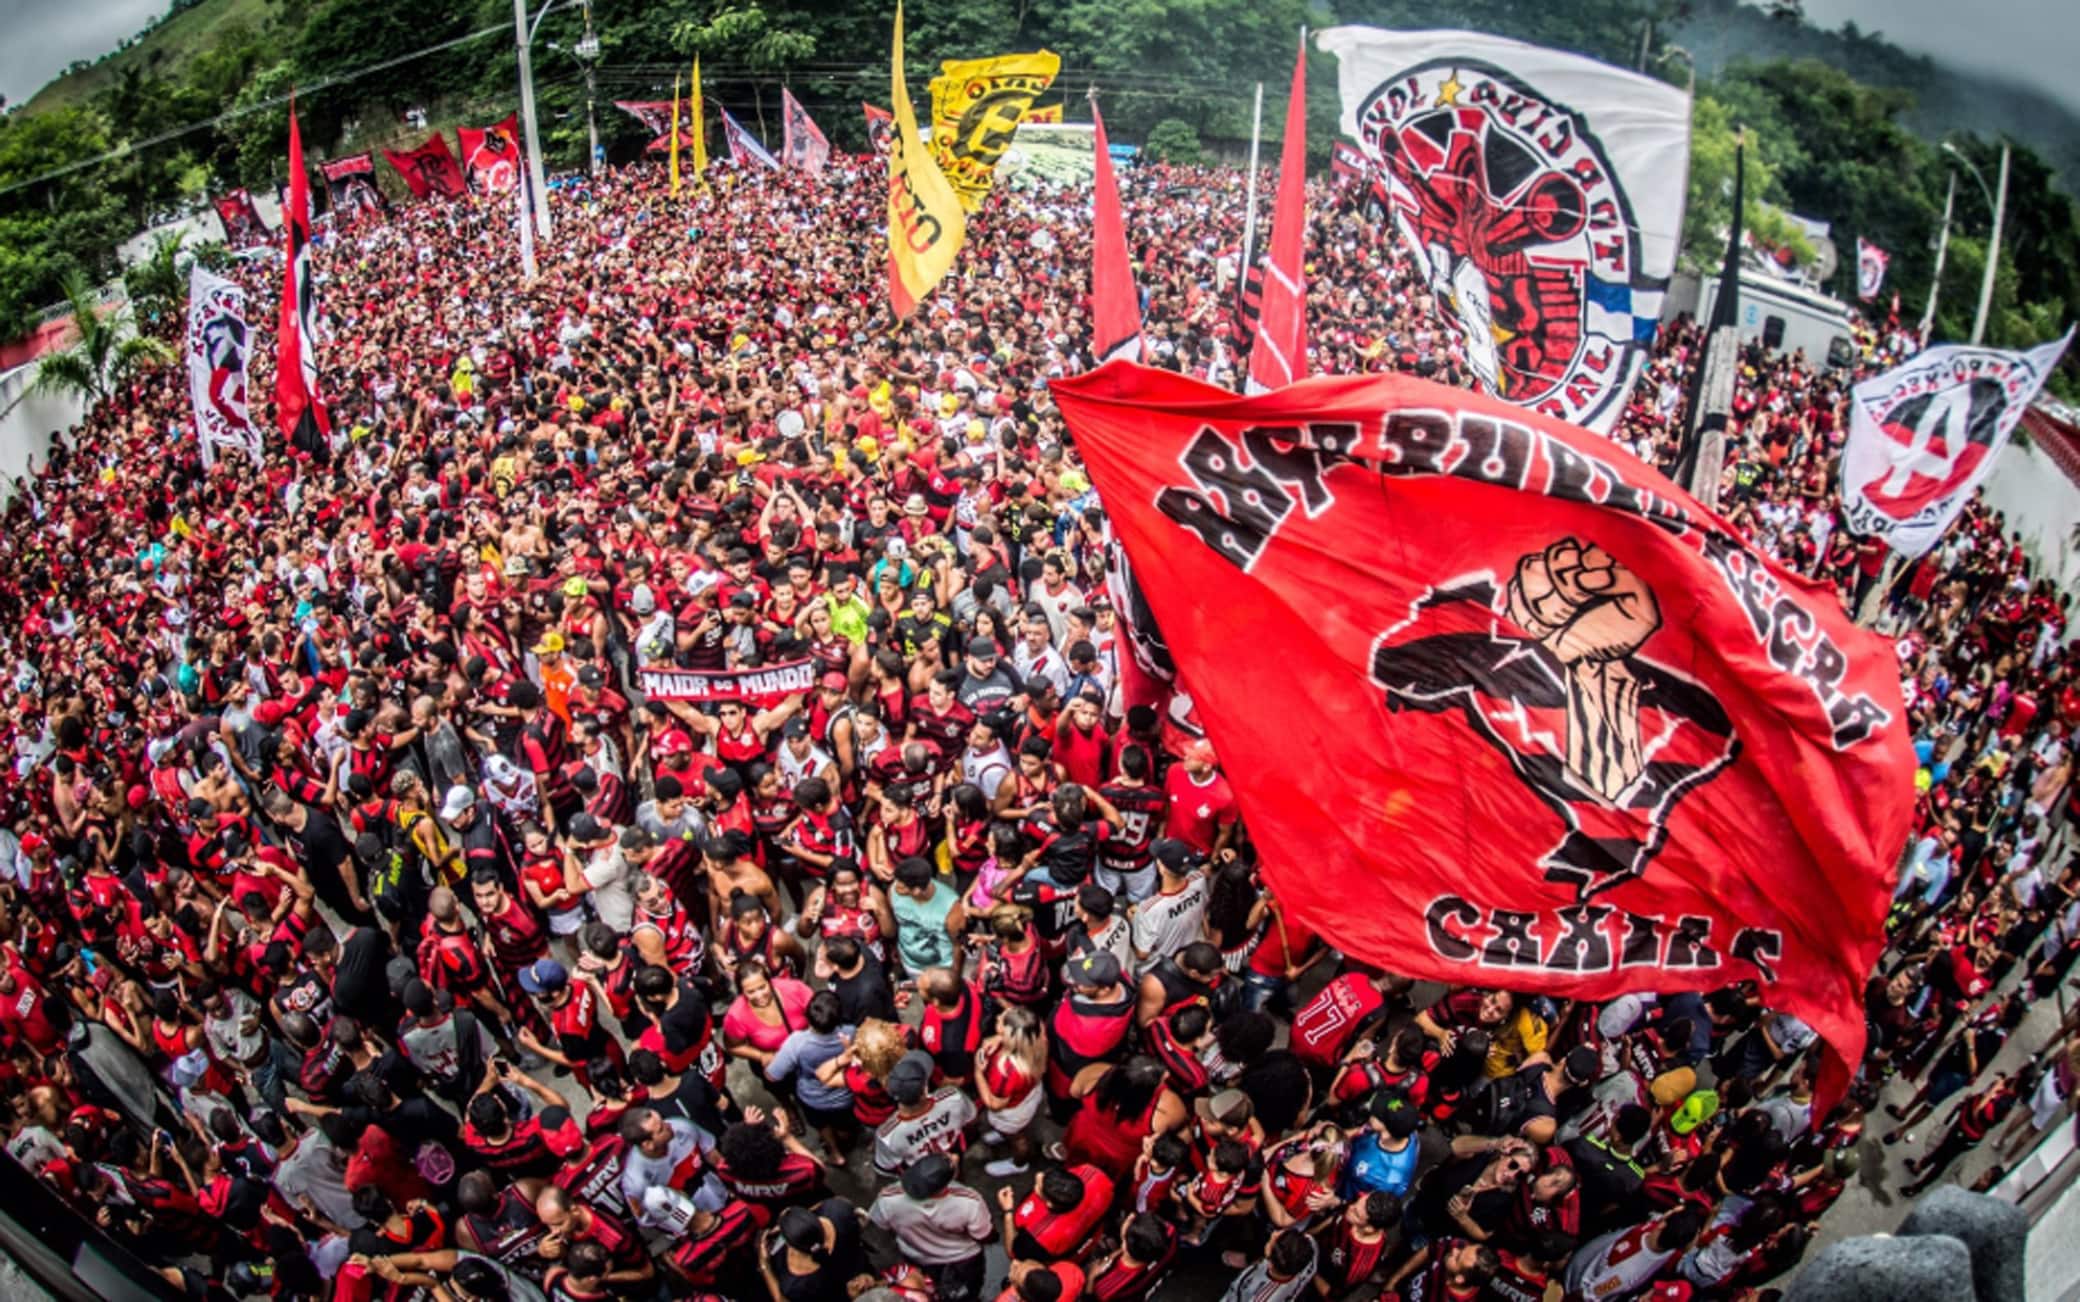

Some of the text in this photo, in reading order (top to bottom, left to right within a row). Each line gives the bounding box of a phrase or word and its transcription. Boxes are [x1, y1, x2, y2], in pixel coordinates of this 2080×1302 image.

[643, 673, 710, 697] MAIOR
[737, 664, 814, 695] MUNDO
[1167, 890, 1202, 920] MRV
[1296, 986, 1347, 1046] 17
[905, 1110, 952, 1147] MRV
[580, 1155, 620, 1201] MRV
[733, 1180, 789, 1198] MRV
